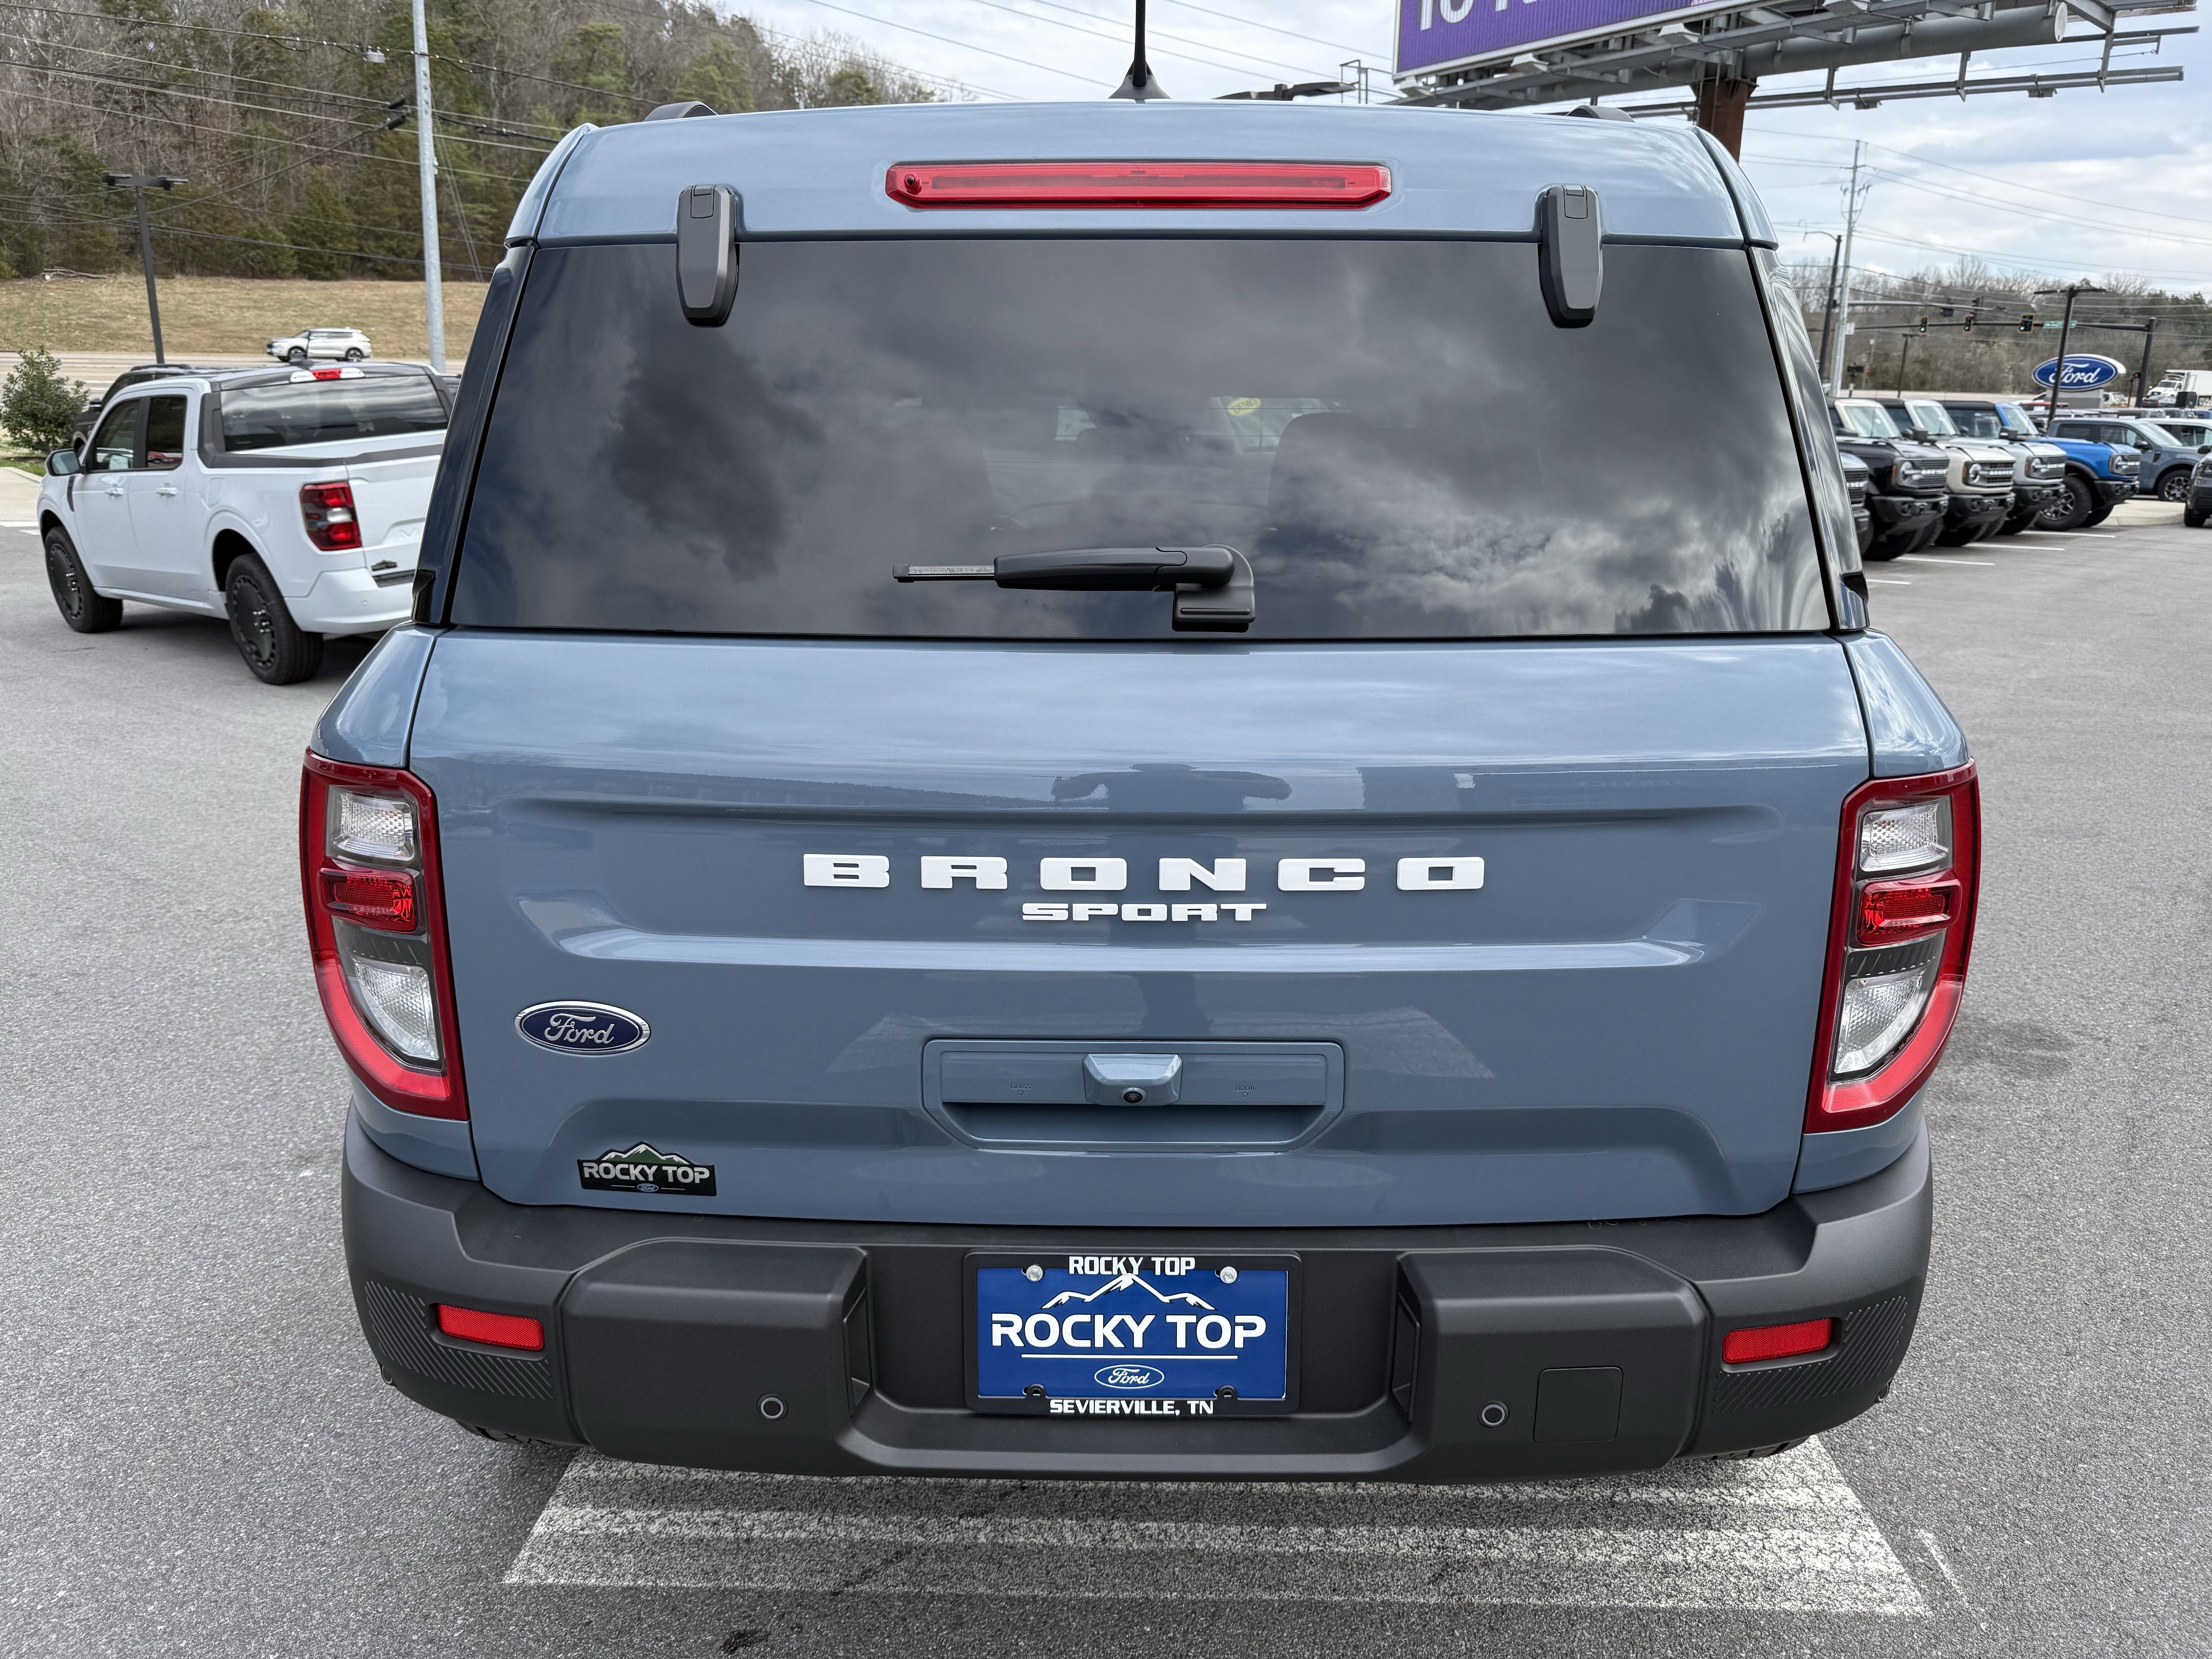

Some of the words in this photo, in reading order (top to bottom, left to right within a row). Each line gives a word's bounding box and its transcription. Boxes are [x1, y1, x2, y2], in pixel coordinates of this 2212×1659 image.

[2049, 363, 2101, 383] Ford
[803, 854, 1484, 891] BRONCO
[1022, 903, 1267, 921] SPORT
[544, 1013, 615, 1044] Ford
[583, 1162, 658, 1182] ROCKY
[663, 1166, 710, 1183] TOP
[1069, 1256, 1144, 1275] ROCKY
[1151, 1257, 1195, 1276] TOP
[991, 1313, 1156, 1348] ROCKY
[1166, 1315, 1266, 1349] TOP
[1108, 1368, 1150, 1384] Ford
[1050, 1399, 1180, 1415] SEVIERVILLE,
[1187, 1400, 1213, 1414] TN
